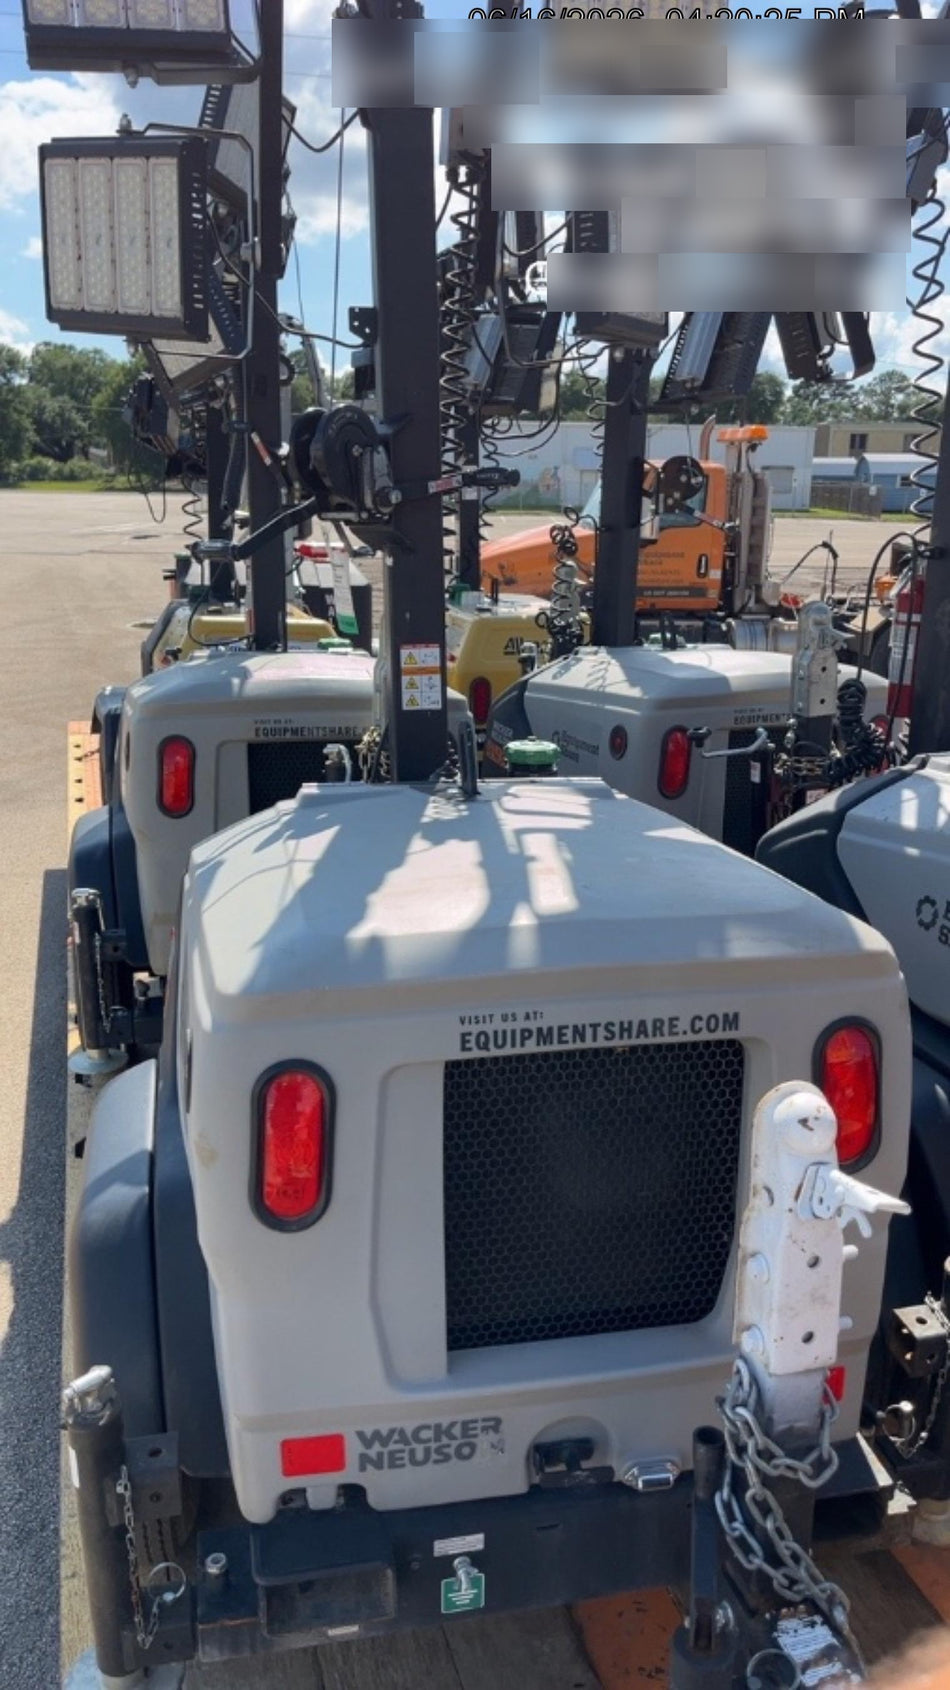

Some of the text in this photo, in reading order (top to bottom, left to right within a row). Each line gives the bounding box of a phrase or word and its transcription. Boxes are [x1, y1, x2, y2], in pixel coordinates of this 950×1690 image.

[459, 1011, 544, 1026] VISIT US AT:
[460, 1012, 740, 1053] EQUIPMENTSHARE.COM
[355, 1416, 503, 1450] WACKER
